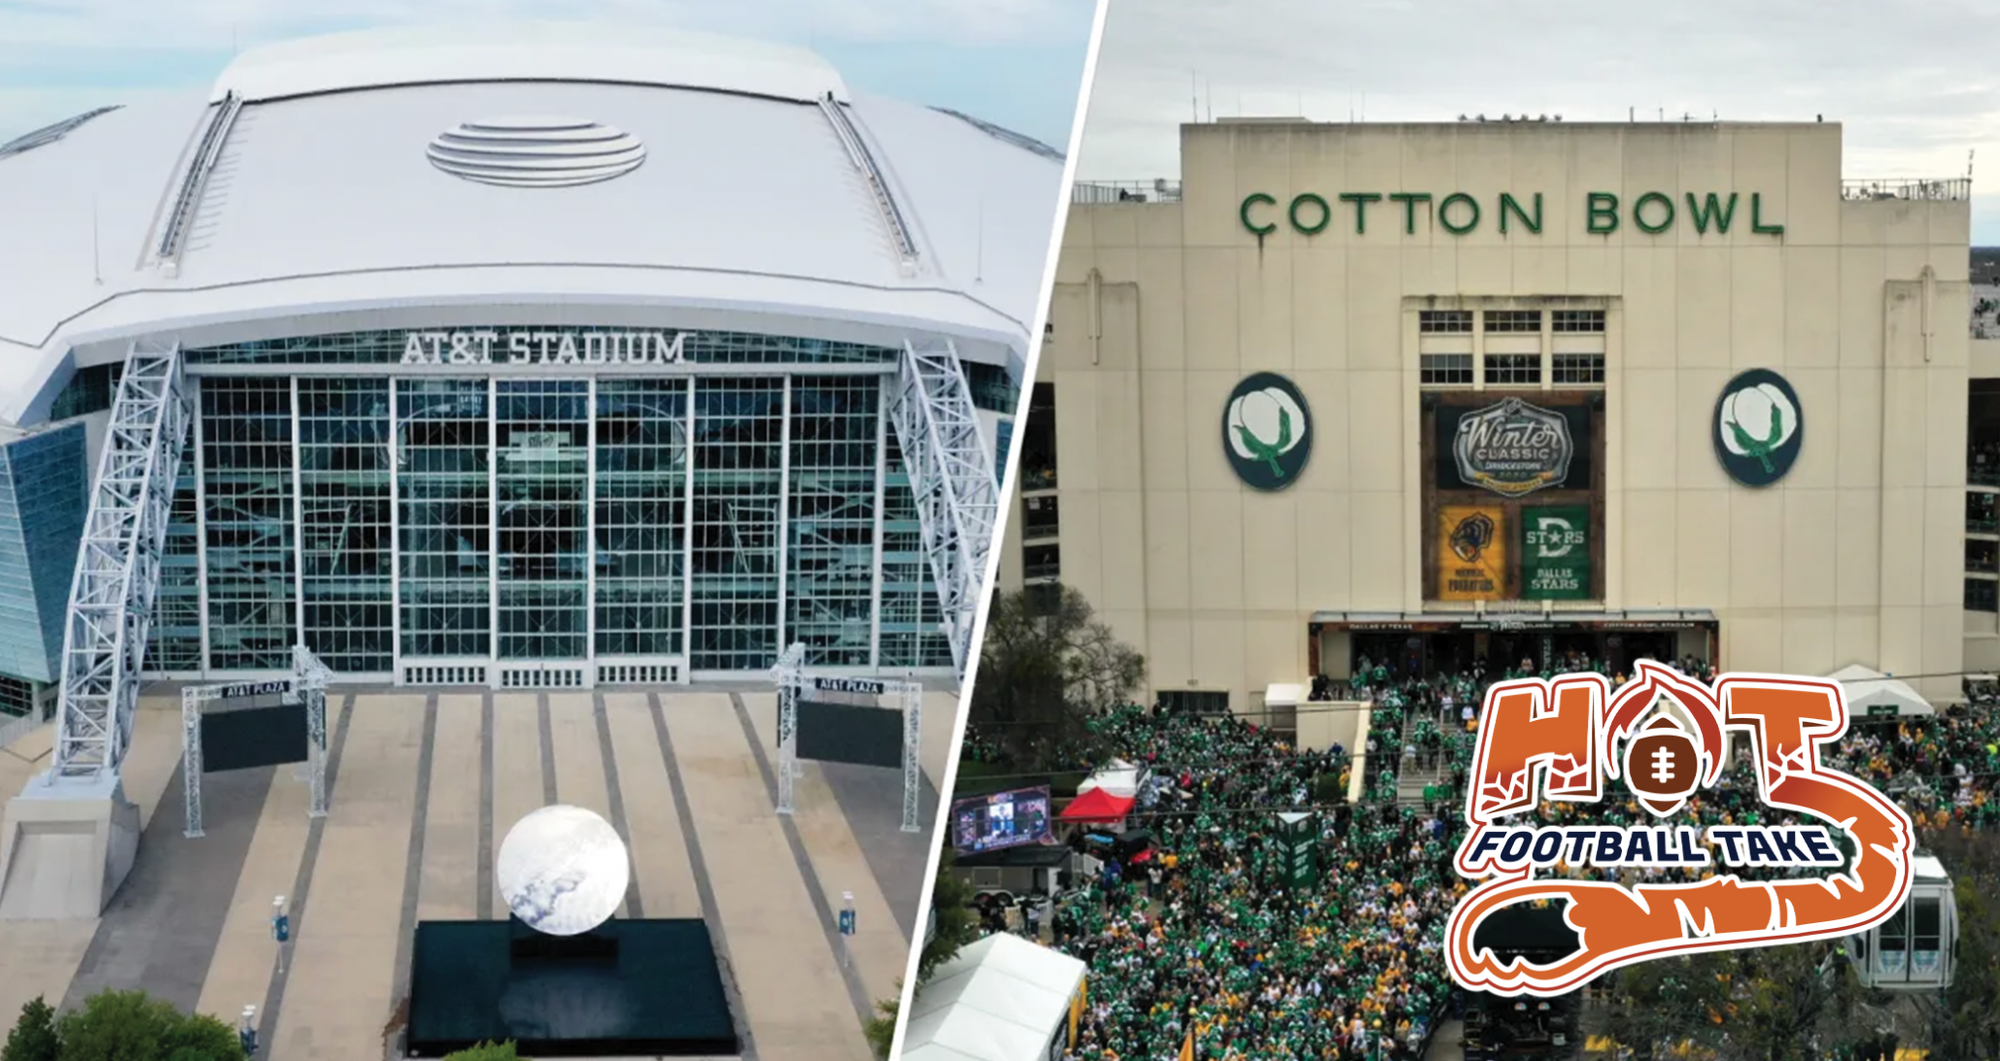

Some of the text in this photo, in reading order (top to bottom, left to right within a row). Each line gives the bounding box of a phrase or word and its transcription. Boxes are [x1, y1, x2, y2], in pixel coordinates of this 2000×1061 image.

[1241, 192, 1784, 235] COTTON BOWL
[400, 332, 686, 364] AT&T STADIUM
[1460, 416, 1559, 456] Winter
[1476, 448, 1550, 460] CLASSIC
[1537, 568, 1573, 578] DALLAS
[1531, 578, 1579, 590] STARS
[227, 681, 285, 698] AT&T PLAZA
[820, 678, 878, 693] AT&T PLAZA
